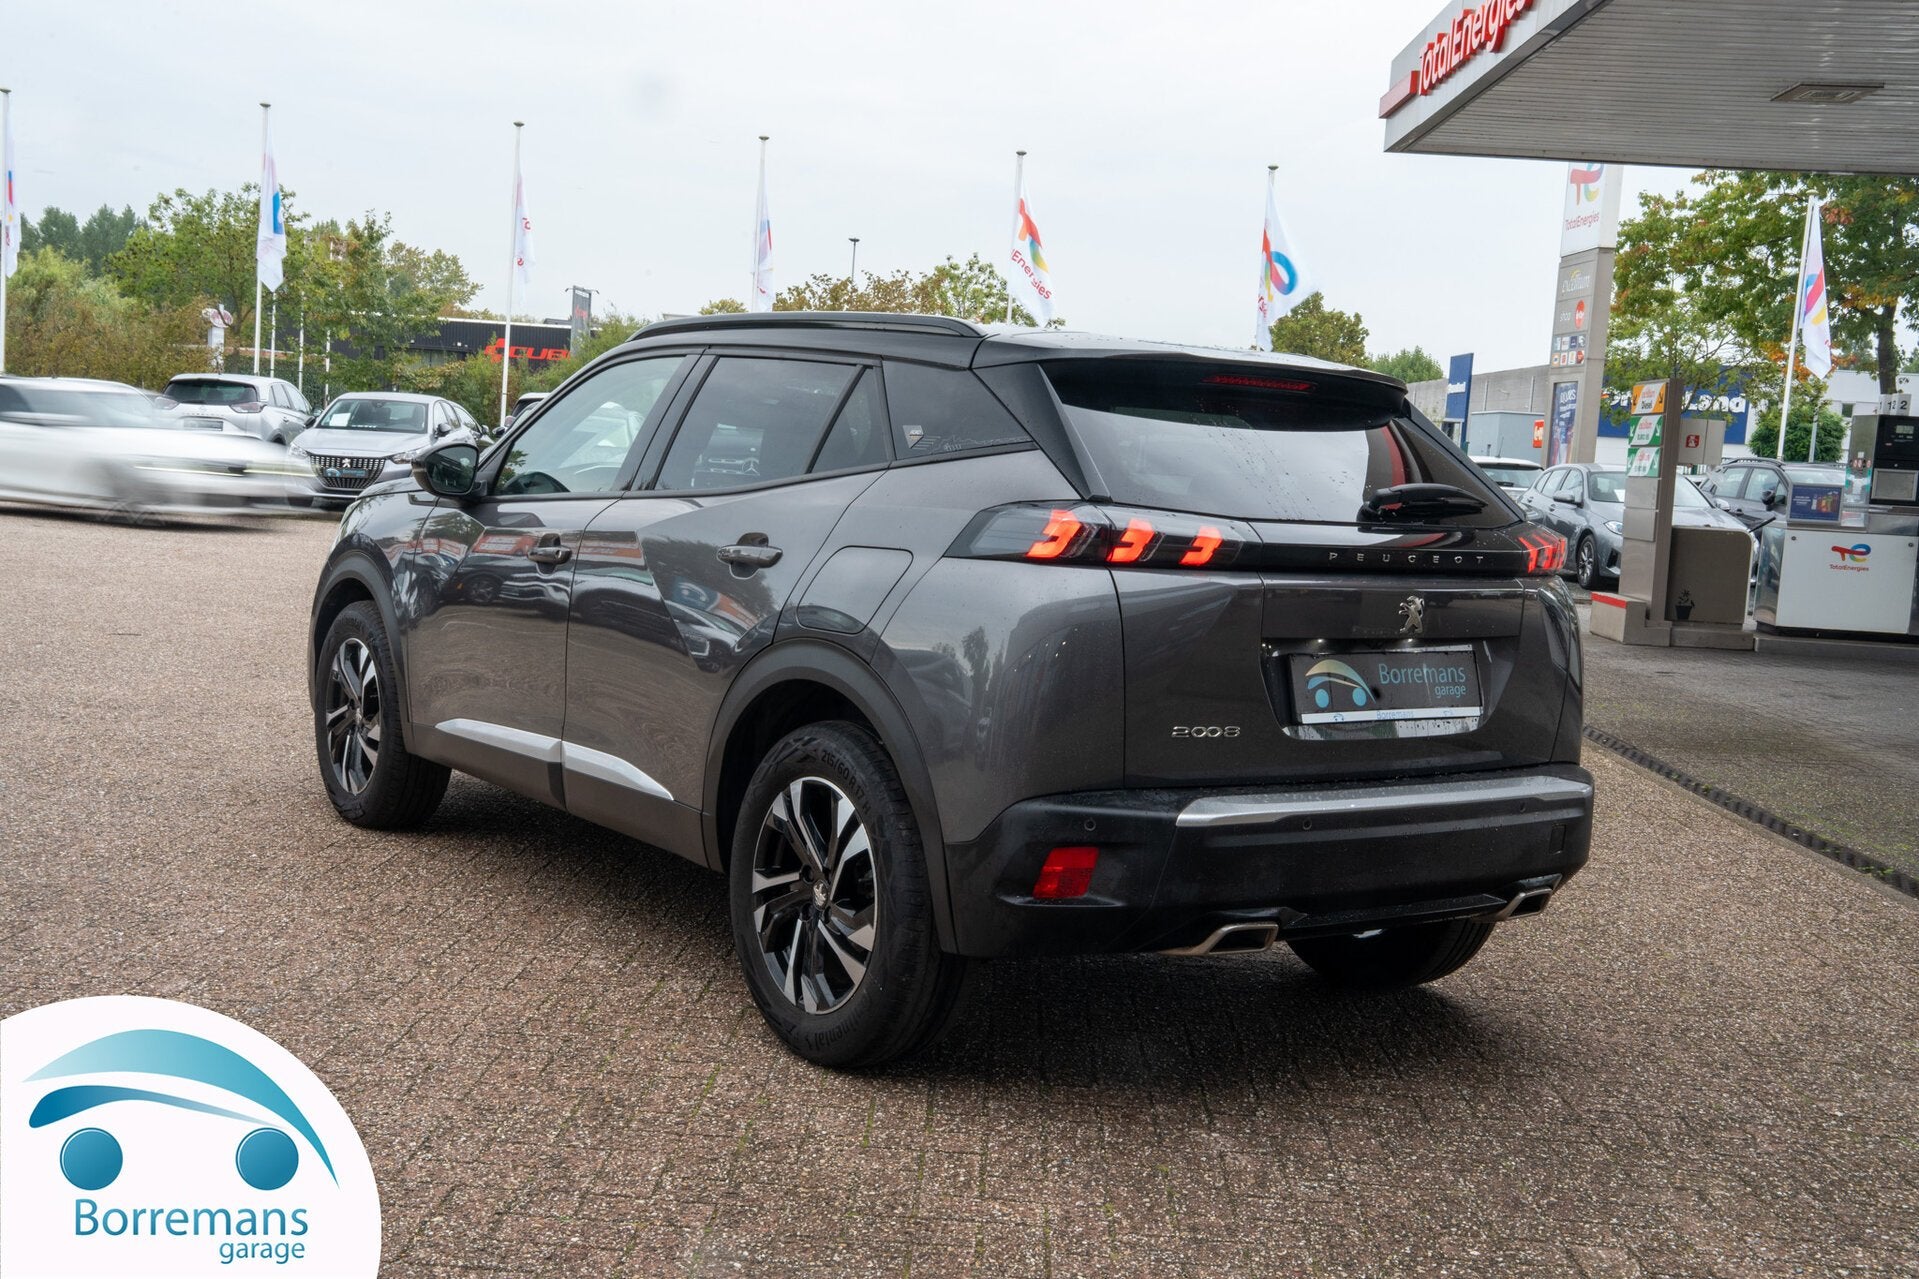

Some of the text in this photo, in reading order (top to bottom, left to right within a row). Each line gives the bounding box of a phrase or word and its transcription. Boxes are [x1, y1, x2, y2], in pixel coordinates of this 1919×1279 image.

[1900, 400, 1908, 410] 2
[1329, 552, 1484, 564] PEUGEOT
[1829, 563, 1870, 573] TotalEnergies
[1378, 663, 1466, 685] Borremans
[1434, 684, 1467, 699] garage
[1171, 726, 1241, 738] 2008
